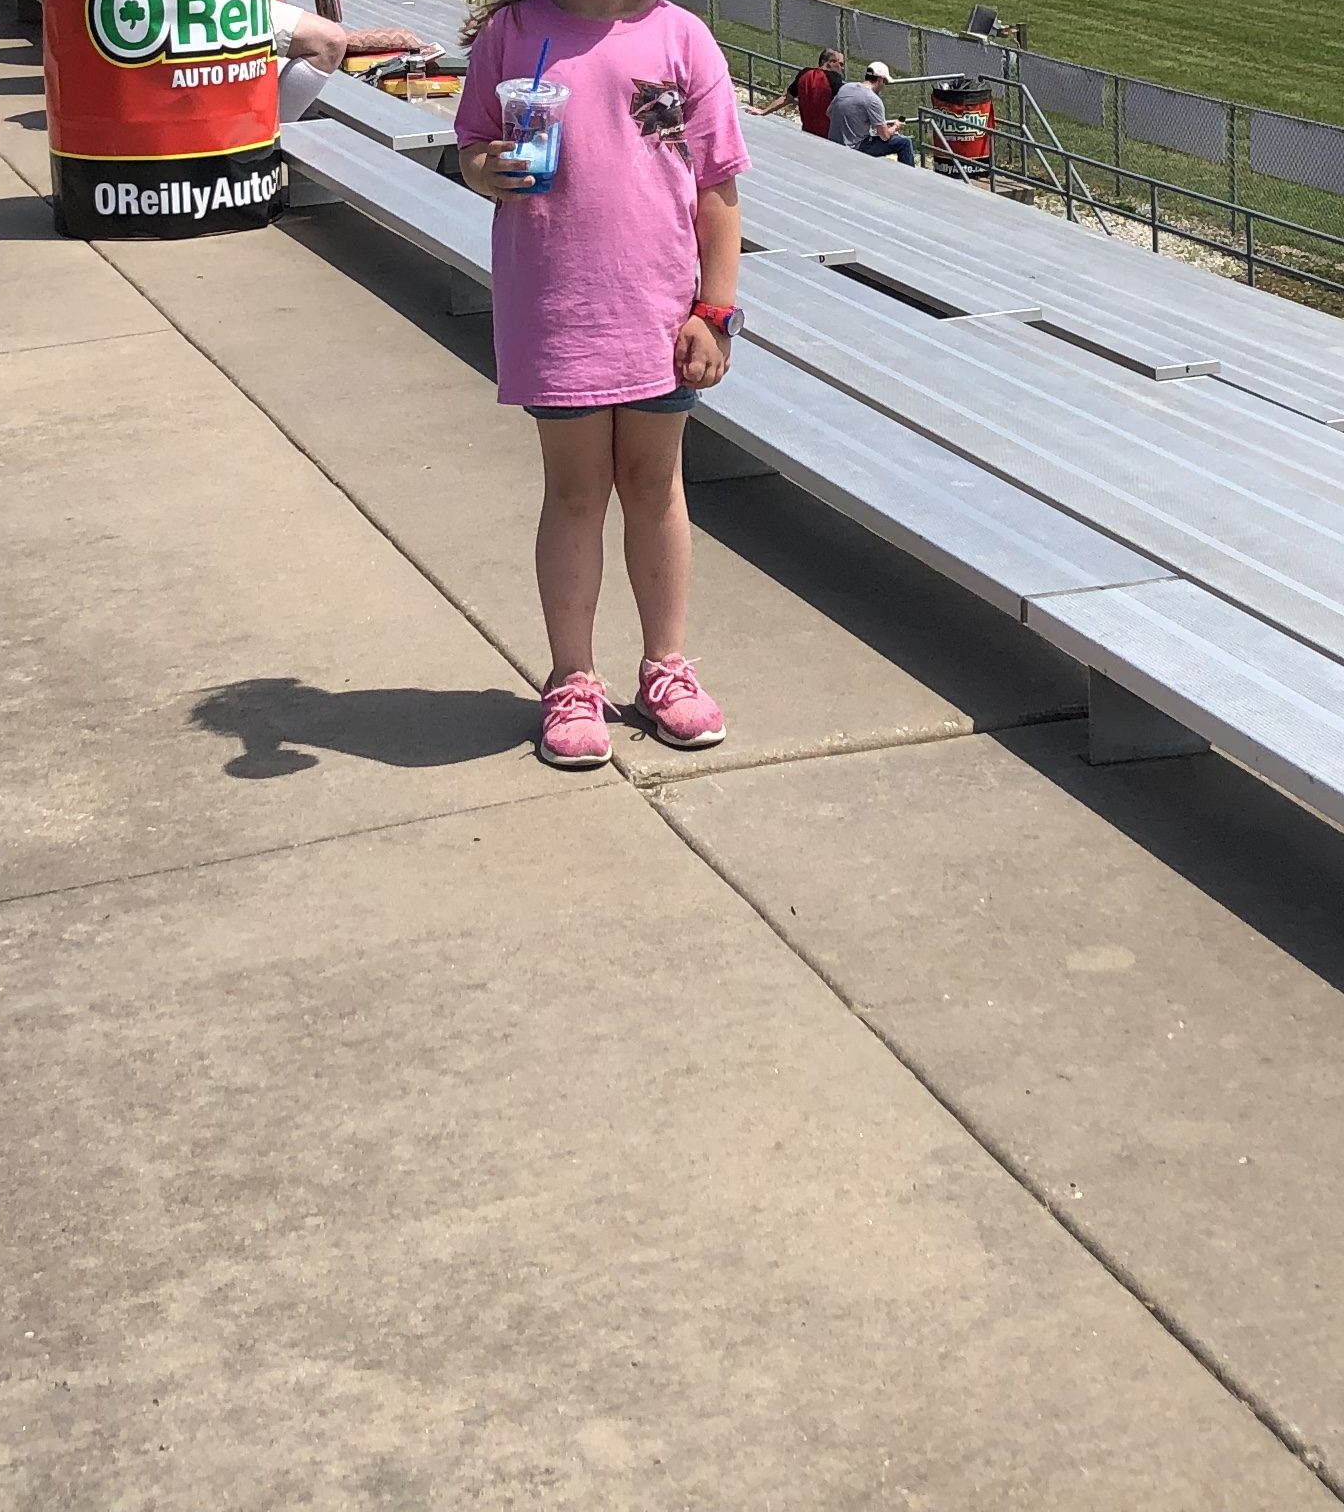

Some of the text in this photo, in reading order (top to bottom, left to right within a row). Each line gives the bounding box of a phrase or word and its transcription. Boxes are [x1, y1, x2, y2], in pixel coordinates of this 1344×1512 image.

[171, 57, 268, 89] AUTO PARTS
[818, 254, 826, 264] D
[1185, 365, 1190, 374] F
